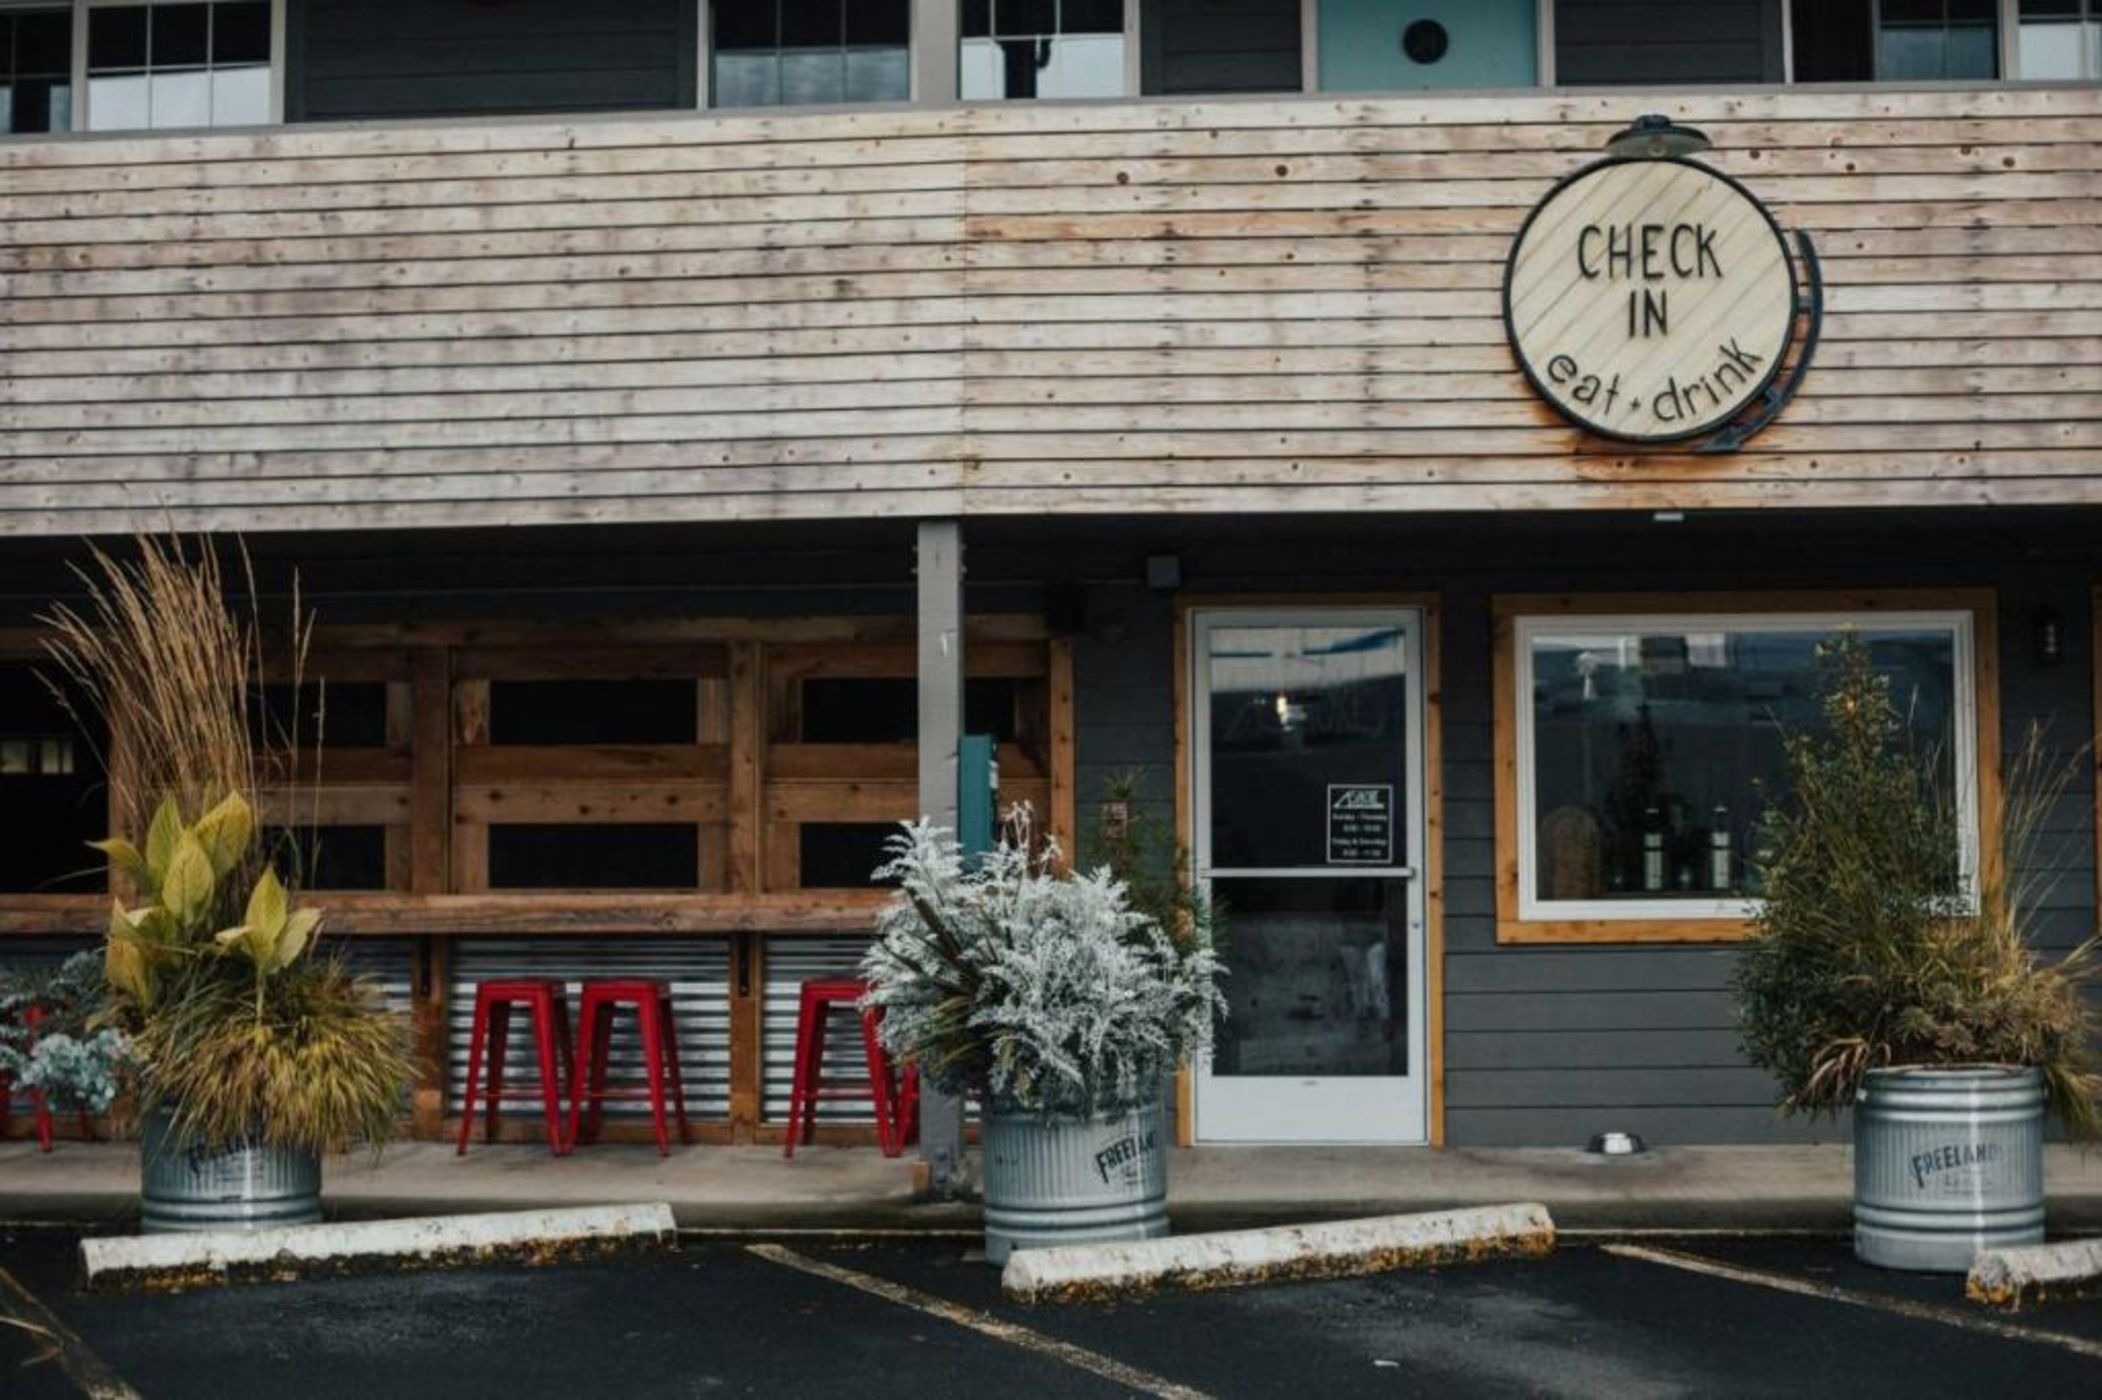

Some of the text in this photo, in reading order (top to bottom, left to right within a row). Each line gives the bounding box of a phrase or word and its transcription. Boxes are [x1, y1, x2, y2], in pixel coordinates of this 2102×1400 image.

[1577, 223, 1722, 280] CHECK
[1628, 289, 1668, 339] IN
[1547, 353, 1620, 416] eat
[1652, 336, 1764, 423] drink
